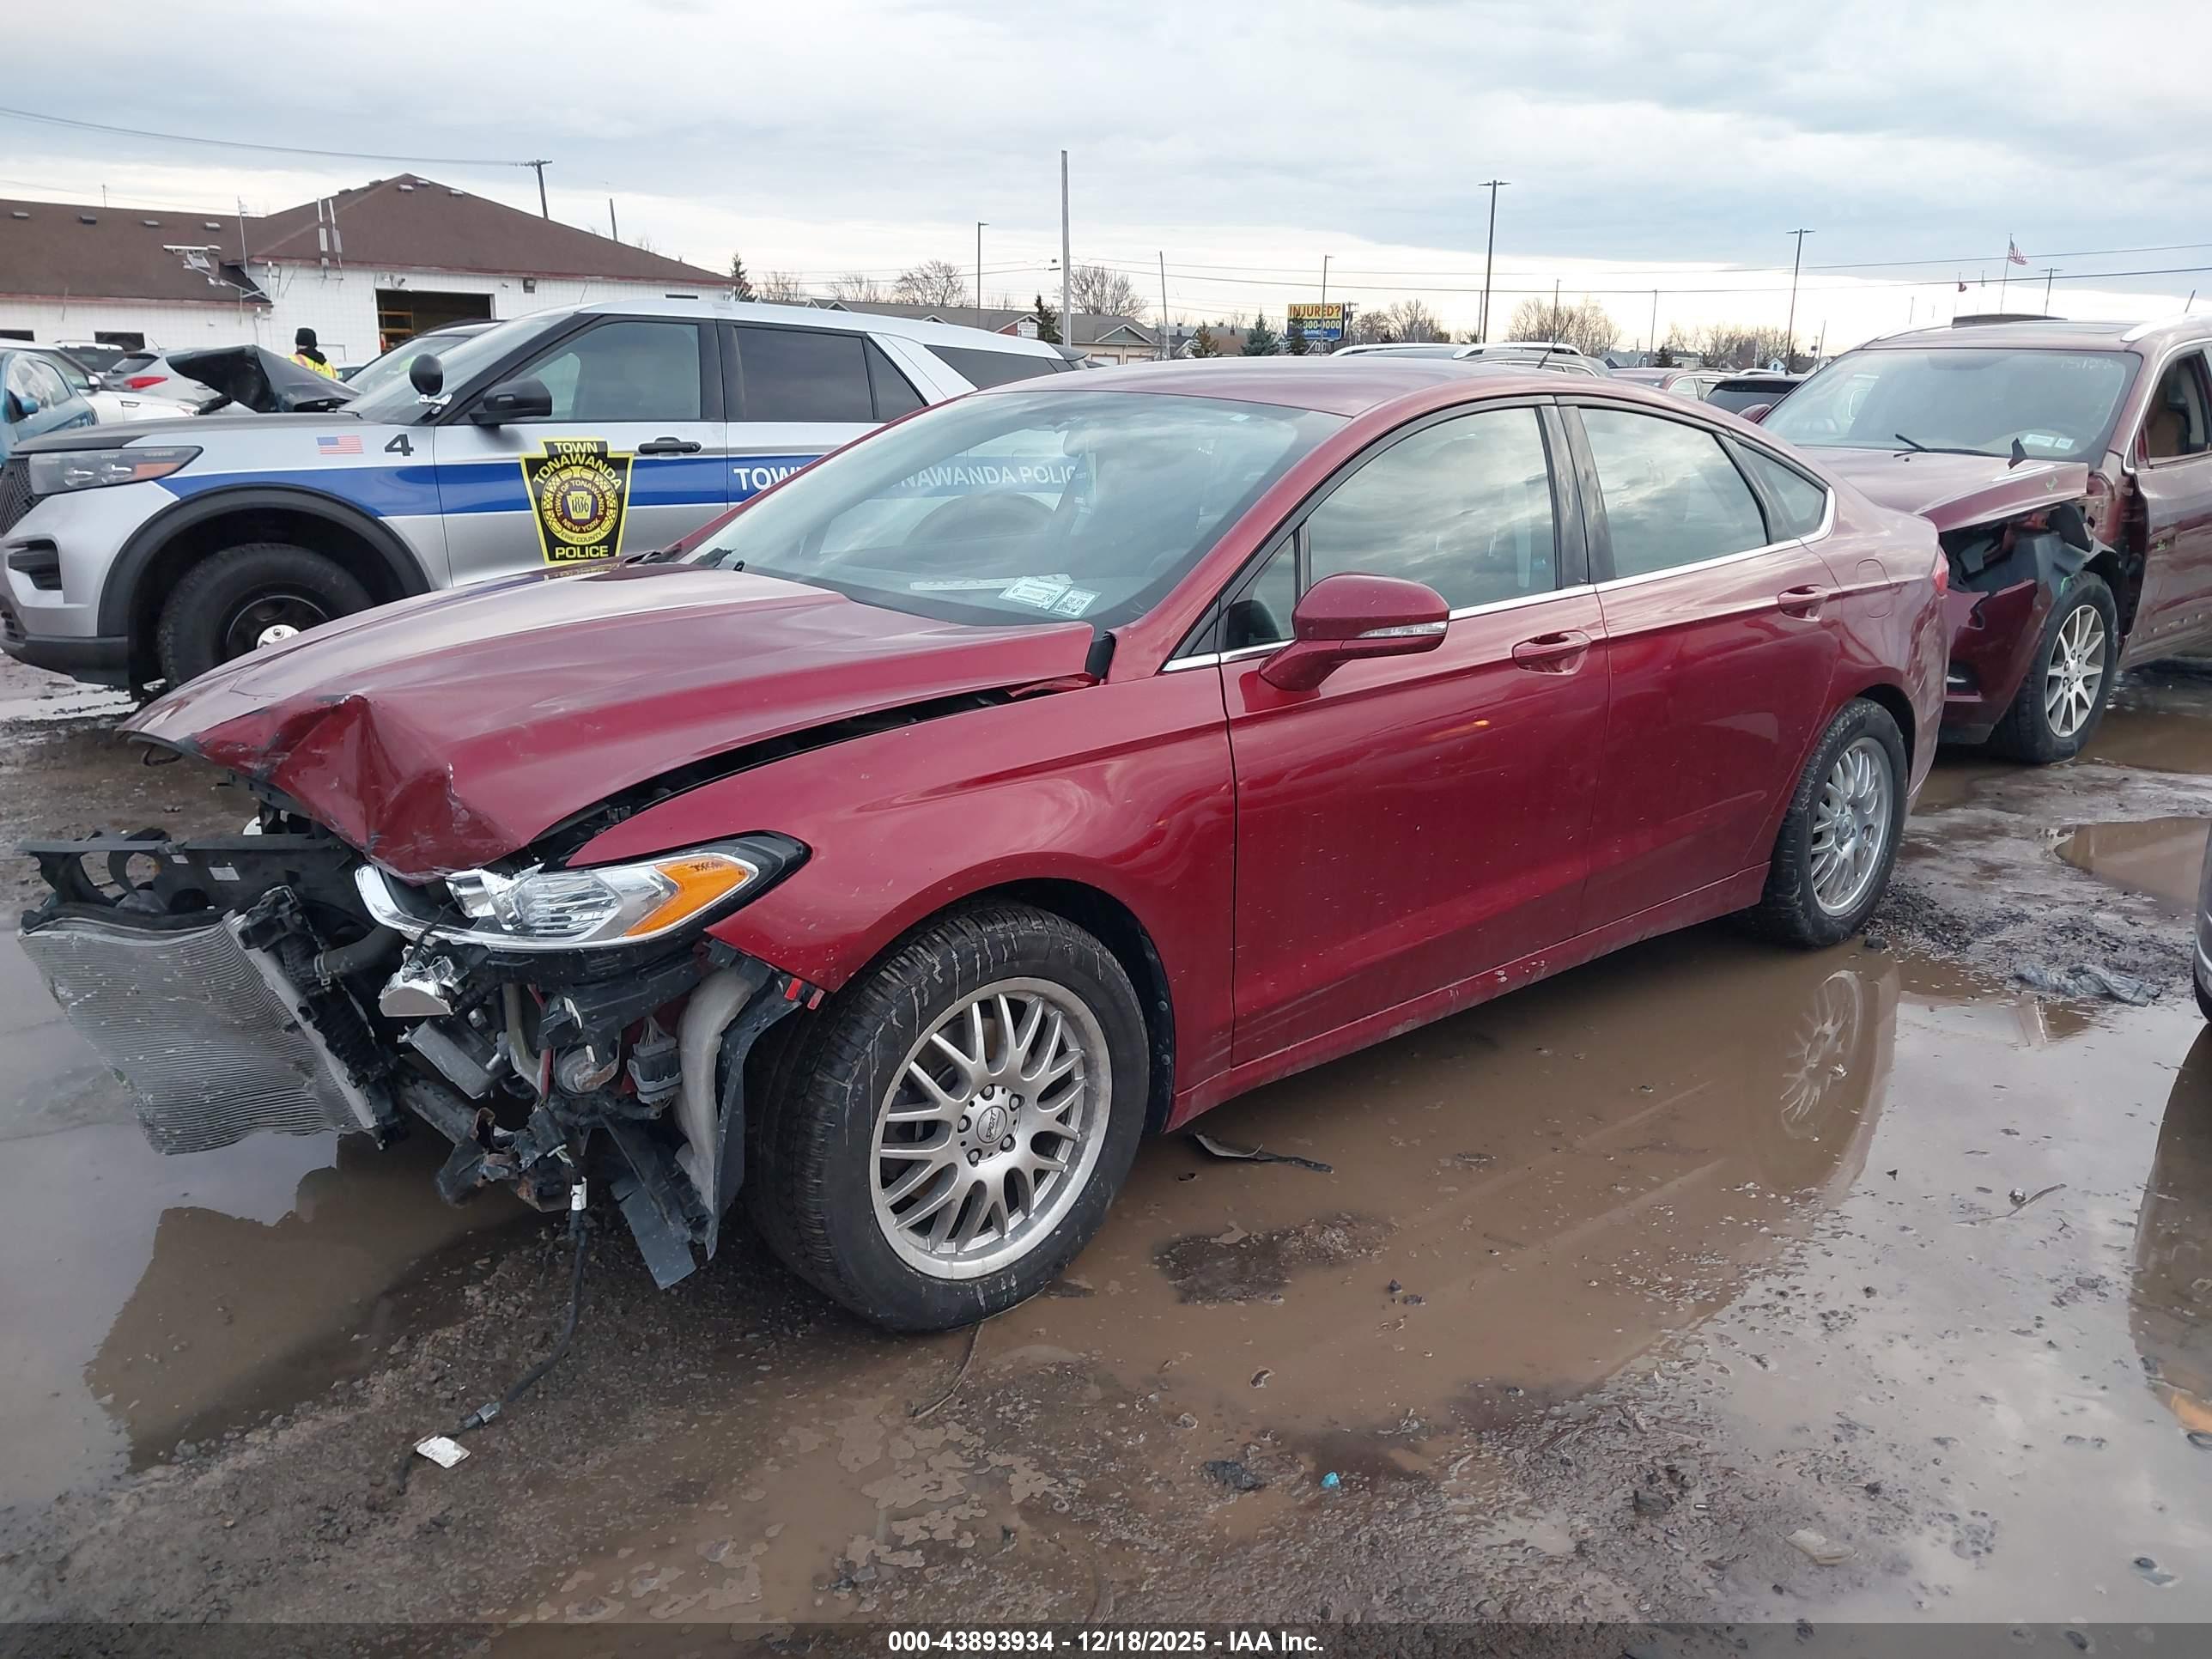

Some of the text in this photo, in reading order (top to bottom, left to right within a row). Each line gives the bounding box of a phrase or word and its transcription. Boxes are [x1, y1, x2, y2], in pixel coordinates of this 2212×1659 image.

[384, 434, 414, 457] 4
[554, 442, 598, 453] TOWN
[532, 453, 623, 490] TONAWANDA
[733, 466, 1076, 491] TOW NAWANDA POLIC
[561, 483, 570, 492] OF
[571, 480, 605, 516] TONAWANDA
[571, 496, 590, 514] 1836
[562, 518, 601, 532] NEW YORK
[576, 531, 602, 543] COUNTY
[555, 545, 609, 559] POLICE
[986, 1109, 996, 1140] SPORT
